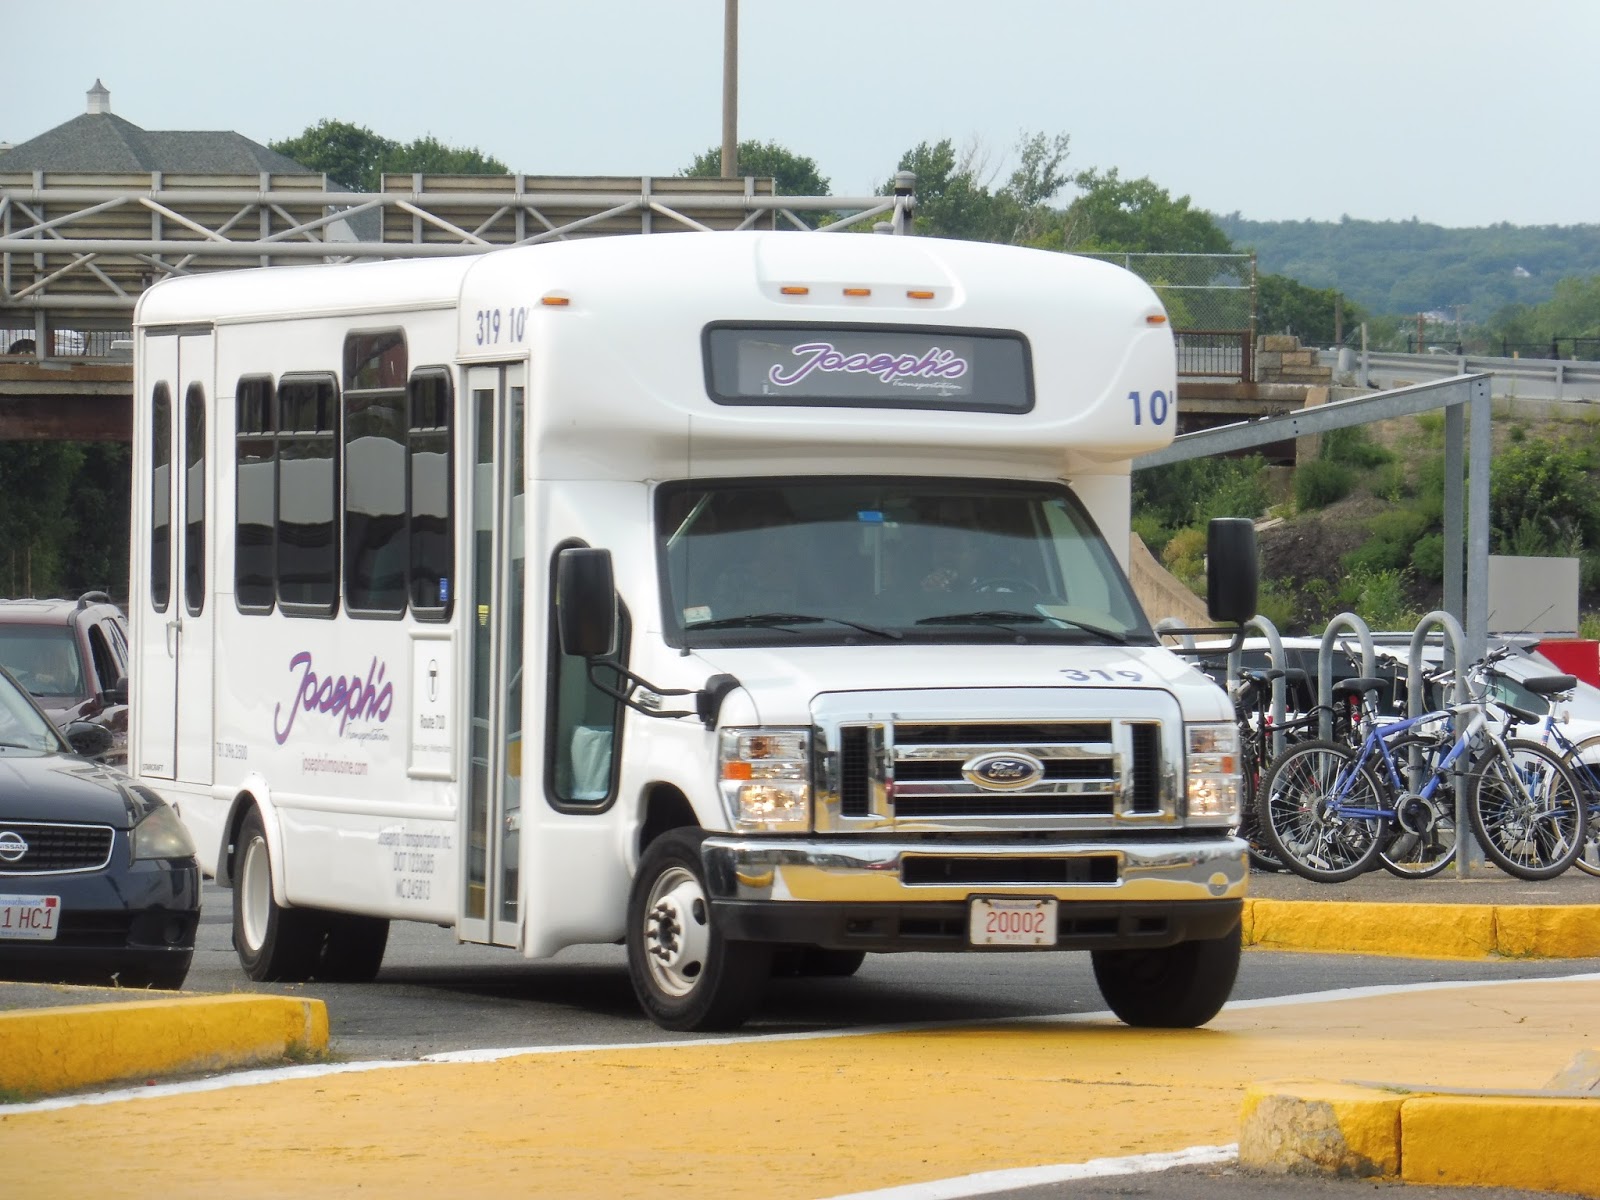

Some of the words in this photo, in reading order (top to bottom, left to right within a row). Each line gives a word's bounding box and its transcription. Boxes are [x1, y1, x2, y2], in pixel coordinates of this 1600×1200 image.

[476, 309, 501, 346] 319
[769, 342, 968, 386] Joseph's
[1059, 669, 1143, 681] 319
[274, 651, 393, 745] Joseph's
[988, 761, 1023, 778] Ford
[19, 908, 52, 929] HC1
[986, 912, 1045, 934] 20002
